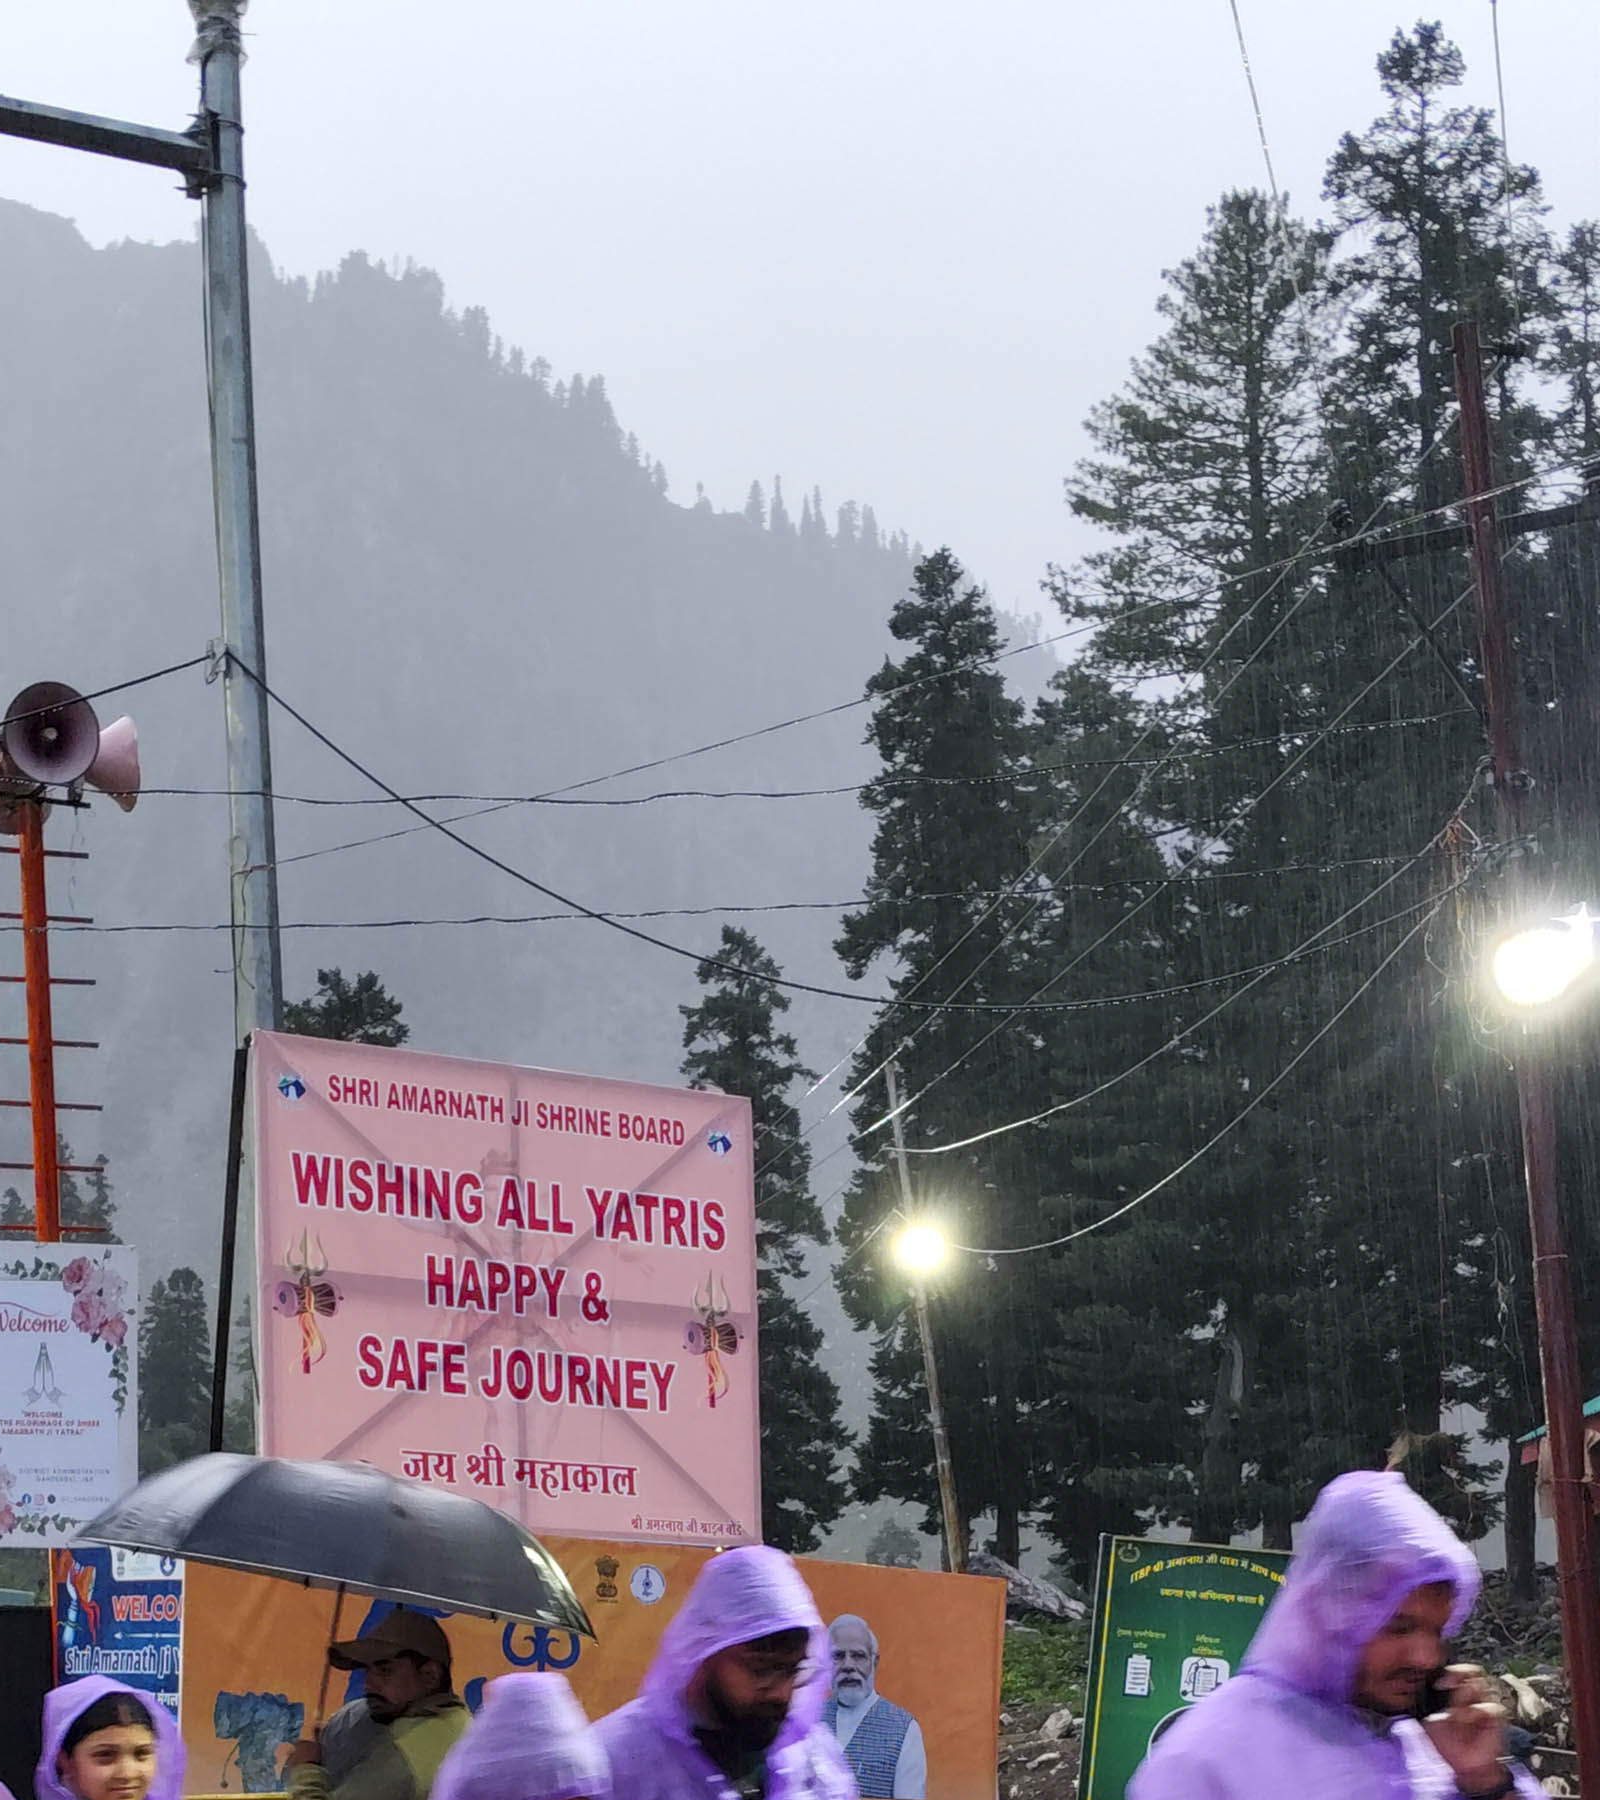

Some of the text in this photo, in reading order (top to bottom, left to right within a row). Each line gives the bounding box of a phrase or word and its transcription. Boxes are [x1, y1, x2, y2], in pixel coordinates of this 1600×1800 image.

[328, 1075, 685, 1146] SHRI AMARNATH JI SHRINE BOARD
[291, 1152, 726, 1250] WISHING ALL YATRIS
[427, 1254, 610, 1322] HAPPY &
[358, 1335, 676, 1411] SAFE JOURNEY
[401, 1443, 638, 1498] जय श्री महाकाल
[112, 1595, 182, 1621] WELCO
[65, 1645, 91, 1674] Shri
[91, 1646, 157, 1674] Amarnath
[157, 1645, 171, 1679] Ji
